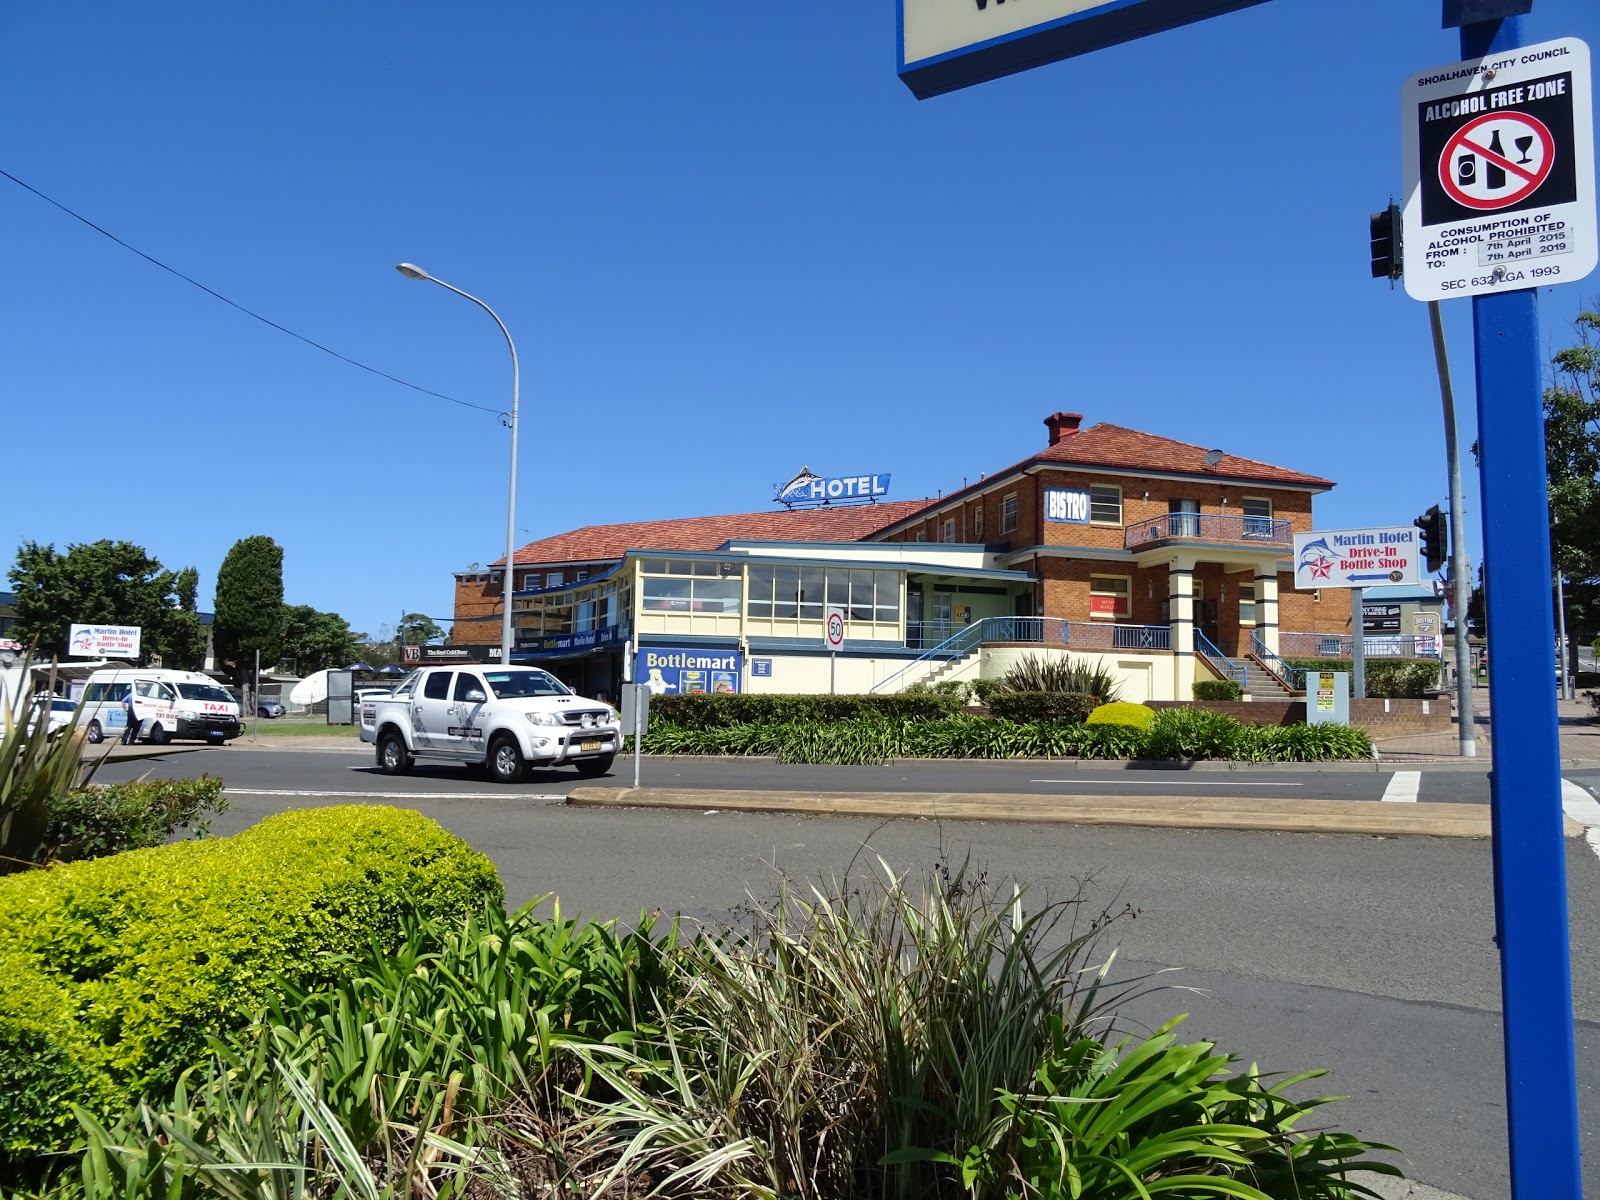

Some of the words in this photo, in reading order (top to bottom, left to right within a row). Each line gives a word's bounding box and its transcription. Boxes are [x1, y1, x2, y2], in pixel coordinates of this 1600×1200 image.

[1418, 65, 1488, 86] SHOALHAVEN
[1491, 58, 1516, 70] CITY
[1521, 47, 1570, 64] COUNCIL
[1426, 97, 1487, 122] ALCOHOL
[1491, 88, 1524, 110] FREE
[1528, 78, 1566, 102] ZONE
[1440, 216, 1530, 238] CONSUMPTION
[1534, 213, 1550, 222] OF
[1428, 234, 1484, 250] ALCOHOL
[1488, 221, 1565, 240] PROHIBITED
[1486, 241, 1503, 250] 7th
[1507, 237, 1531, 249] April
[1539, 232, 1566, 242] 2015
[1487, 252, 1504, 261] 7th
[1507, 248, 1532, 260] April
[1540, 242, 1566, 253] 2019
[1426, 260, 1446, 269] TO:
[1441, 279, 1466, 291] SEC
[1471, 275, 1494, 286] 632
[1499, 271, 1524, 282] LGA
[1530, 266, 1560, 278] 1993
[810, 476, 884, 498] HOTEL
[1049, 490, 1086, 520] BISTRO
[1333, 533, 1374, 546] Marlin
[1379, 531, 1413, 544] Hotel
[1349, 546, 1397, 559] Drive-In
[1340, 559, 1374, 570] Bottle
[1378, 558, 1407, 569] Shop
[830, 622, 841, 637] 50
[544, 639, 570, 649] Bottlemart
[405, 649, 419, 660] VB
[646, 652, 736, 670] Bottlemart
[203, 703, 228, 712] TAXI
